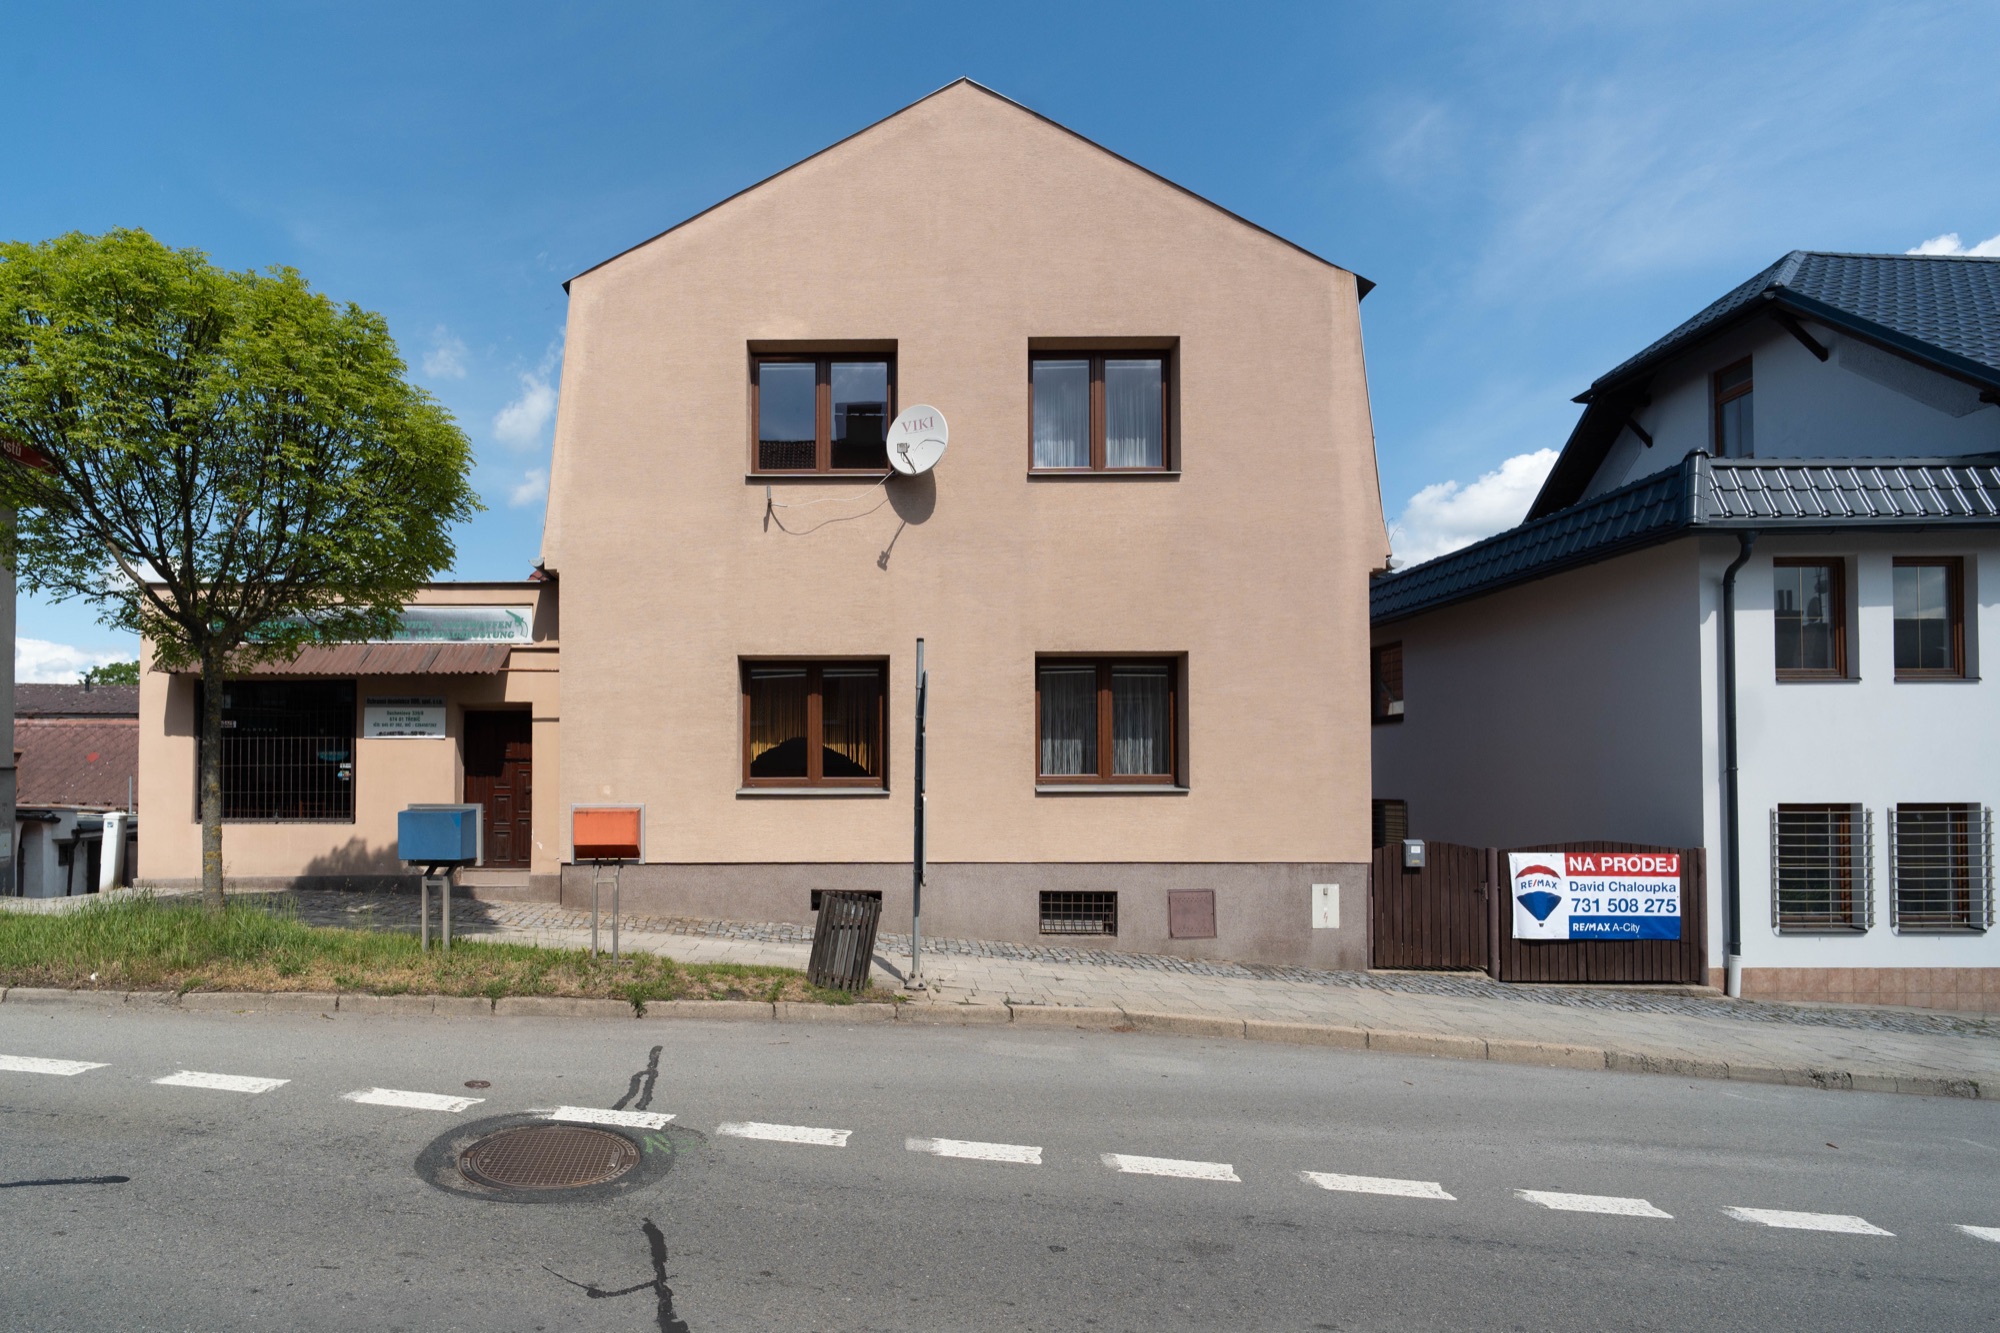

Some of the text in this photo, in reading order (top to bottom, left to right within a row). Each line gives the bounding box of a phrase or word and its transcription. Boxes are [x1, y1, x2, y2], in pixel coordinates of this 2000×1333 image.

[901, 416, 934, 433] VIKI
[1569, 856, 1678, 873] NA PRODEJ
[1520, 878, 1558, 891] RE/MAX
[1569, 880, 1677, 895] David Chaloupka
[1571, 897, 1677, 913] 731 508 275
[1572, 922, 1641, 933] RE/MAX A-City
